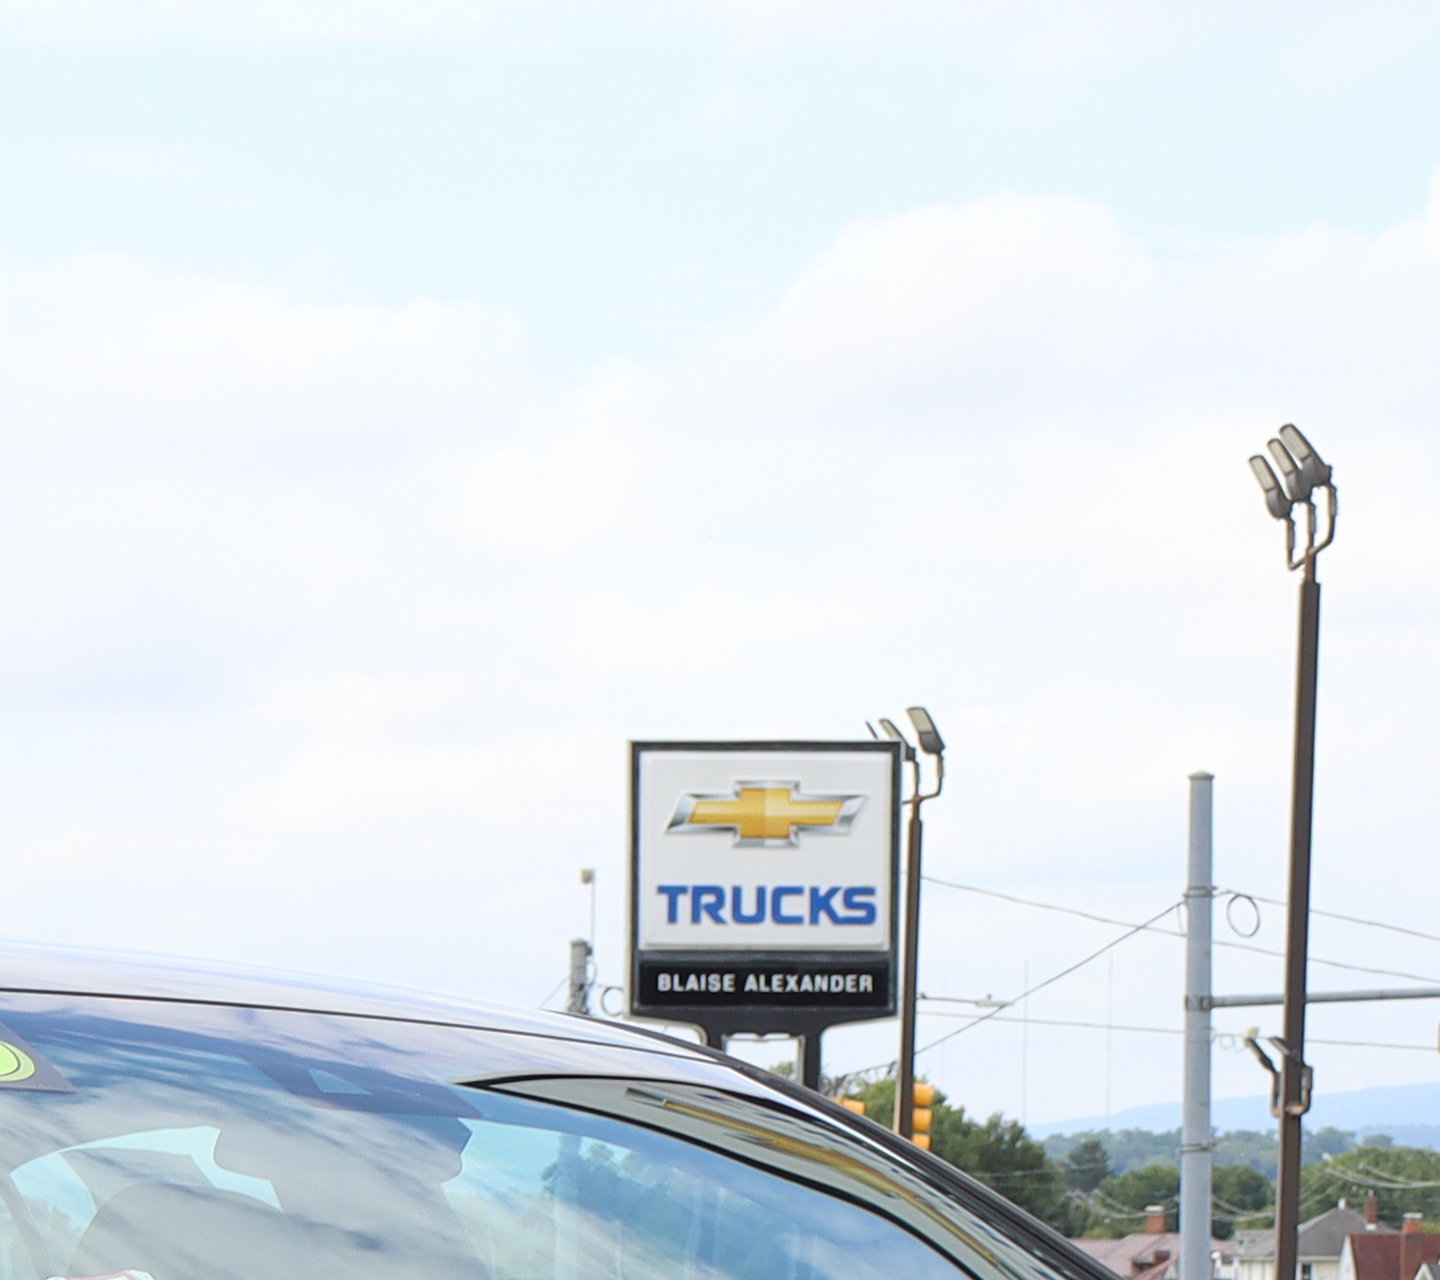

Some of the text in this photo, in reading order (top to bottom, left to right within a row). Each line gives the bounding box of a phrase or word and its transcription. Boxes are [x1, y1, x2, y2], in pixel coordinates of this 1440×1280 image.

[657, 884, 877, 926] TRUCKS
[657, 972, 874, 993] BLAISE ALEXANDER
